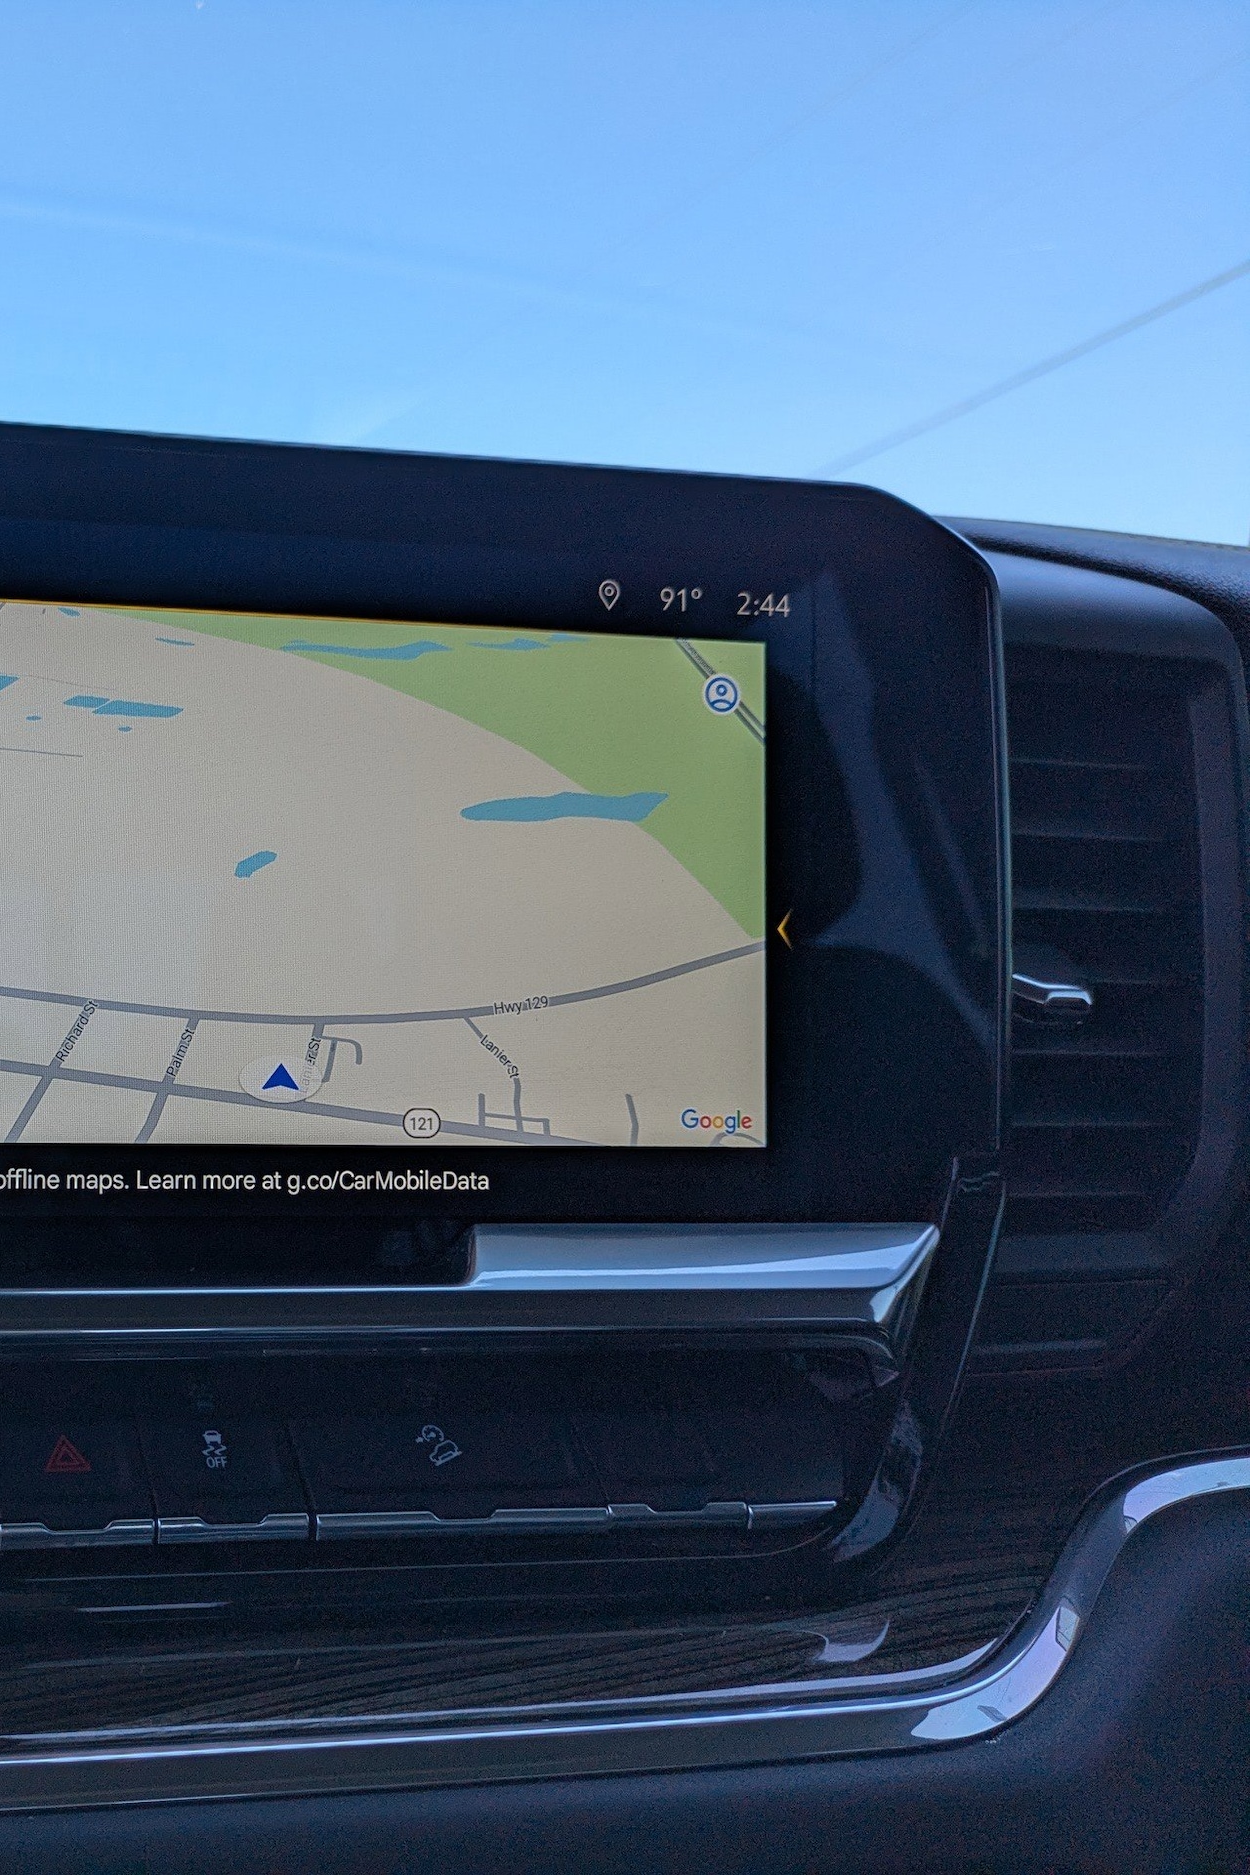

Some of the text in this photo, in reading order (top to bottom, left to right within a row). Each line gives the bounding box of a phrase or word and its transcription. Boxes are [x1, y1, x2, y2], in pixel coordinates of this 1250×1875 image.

[736, 592, 791, 618] 2:44
[493, 995, 549, 1015] Hwy 129
[55, 1000, 99, 1062] Richard St
[166, 1028, 196, 1077] Palm St
[308, 1037, 322, 1052] St
[480, 1034, 520, 1079] Lanier St
[409, 1116, 434, 1131] 121
[681, 1108, 753, 1135] Google
[66, 1173, 130, 1195] maps.
[136, 1169, 197, 1190] Learn
[202, 1173, 256, 1190] more
[261, 1170, 282, 1190] at
[286, 1169, 490, 1196] g.co/CarMobileData
[206, 1456, 228, 1469] OFF
